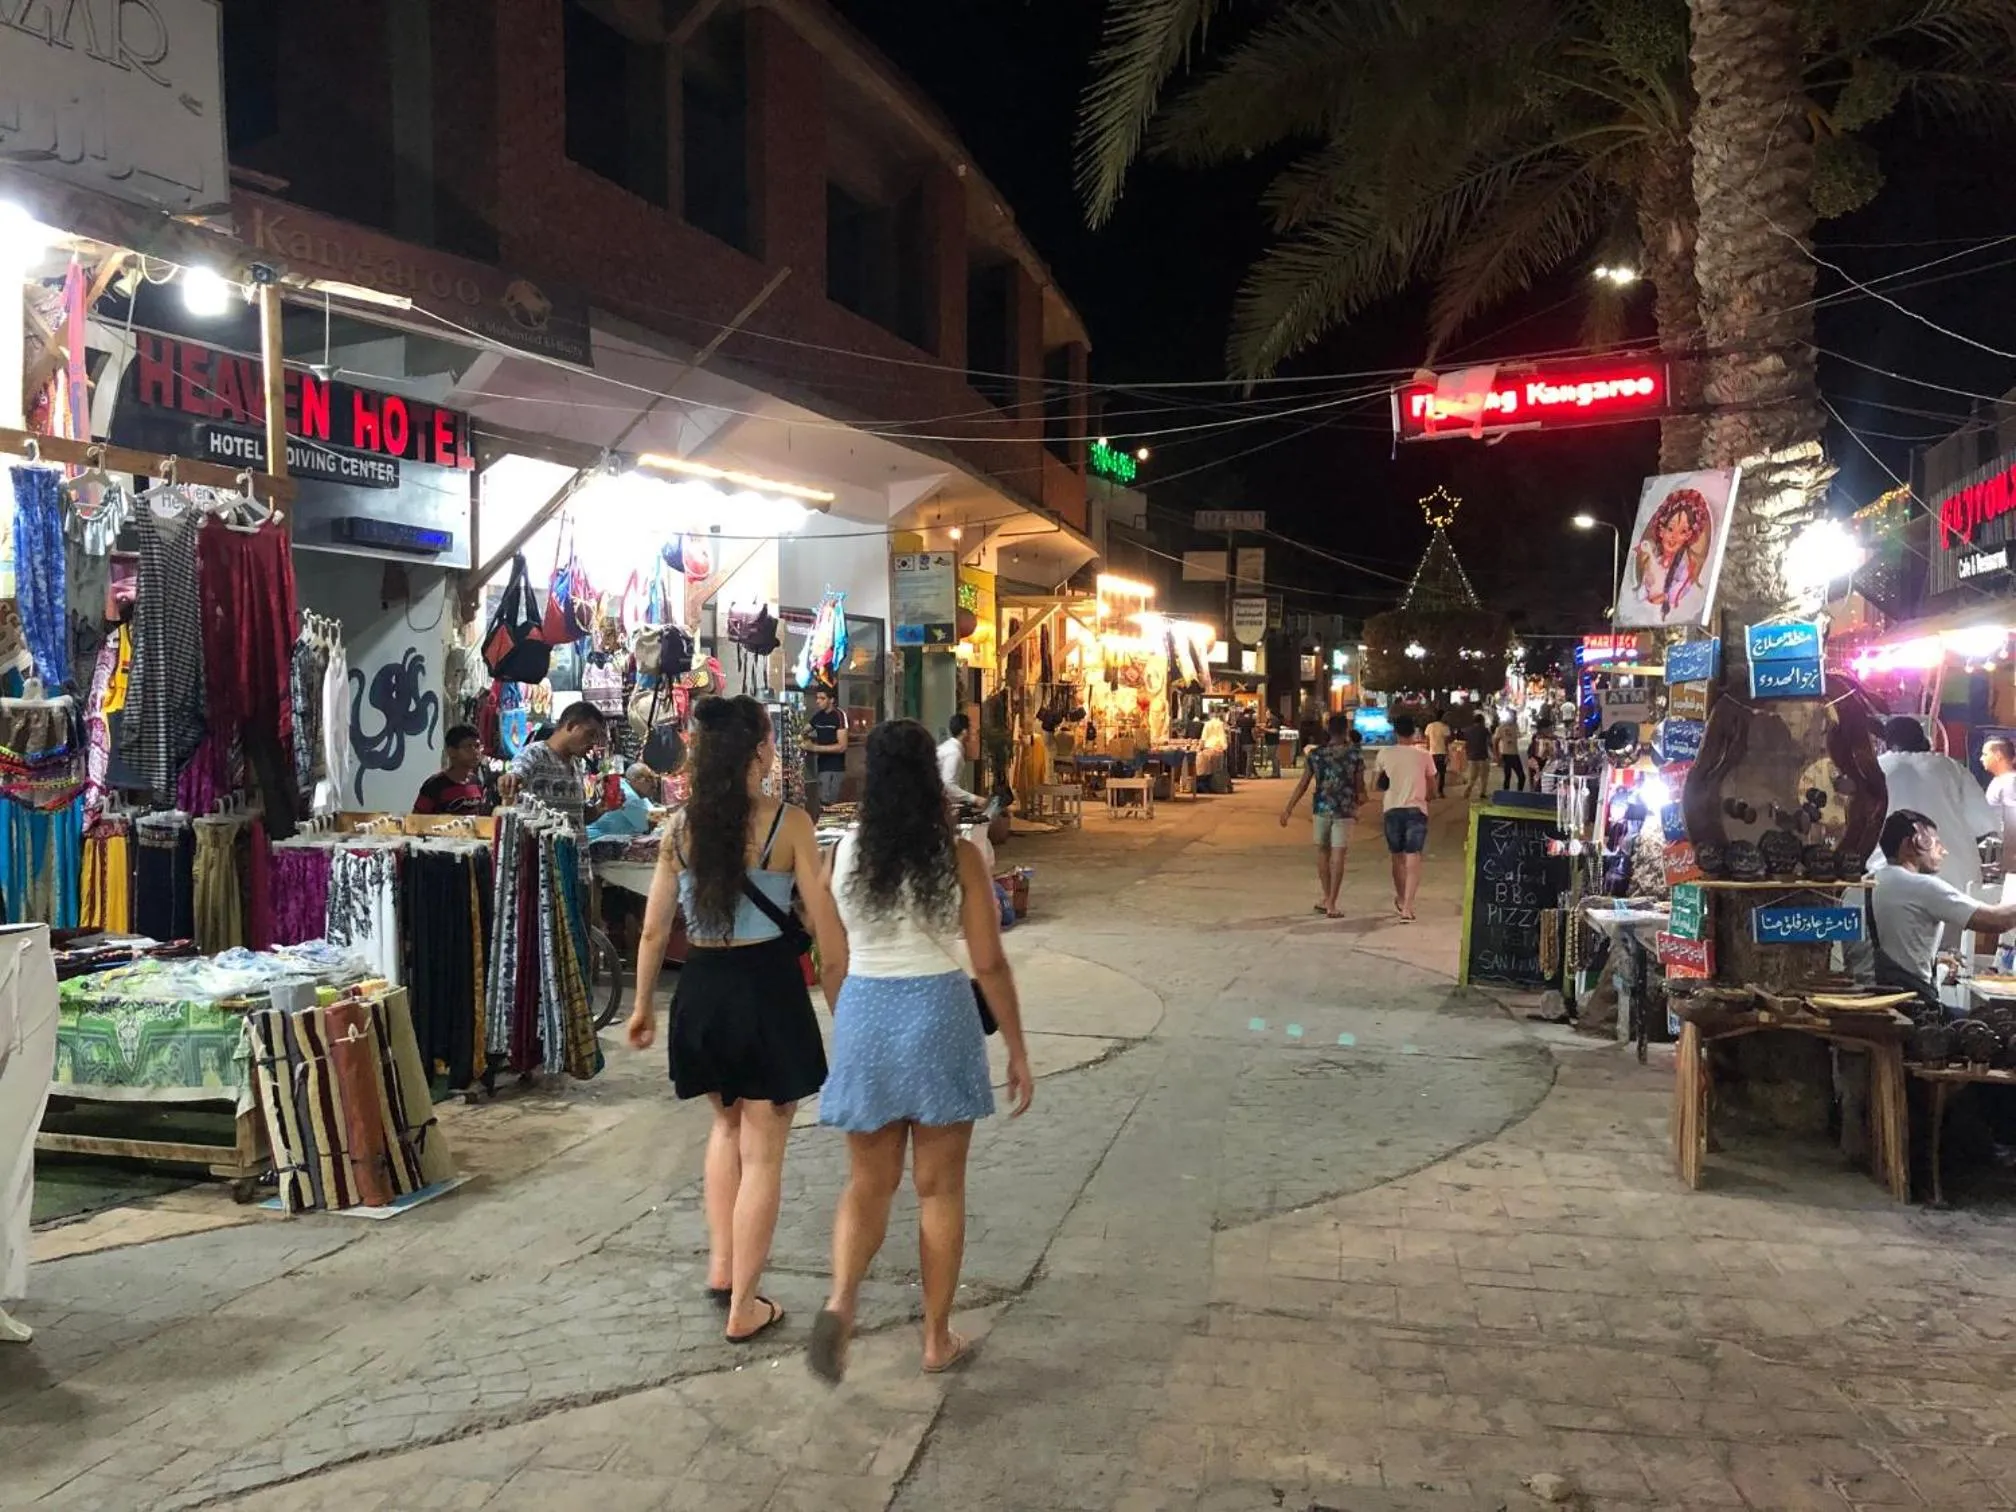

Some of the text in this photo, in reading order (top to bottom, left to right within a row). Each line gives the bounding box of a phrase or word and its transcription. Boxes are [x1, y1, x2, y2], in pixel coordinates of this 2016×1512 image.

[256, 207, 481, 305] Kangaroo
[1411, 376, 1655, 420] Flng Kangaroo
[353, 388, 475, 471] HOTEL
[210, 432, 396, 482] HOTEL DIVING CENTER
[1583, 635, 1637, 648] PHARACY
[1608, 690, 1645, 704] ATM
